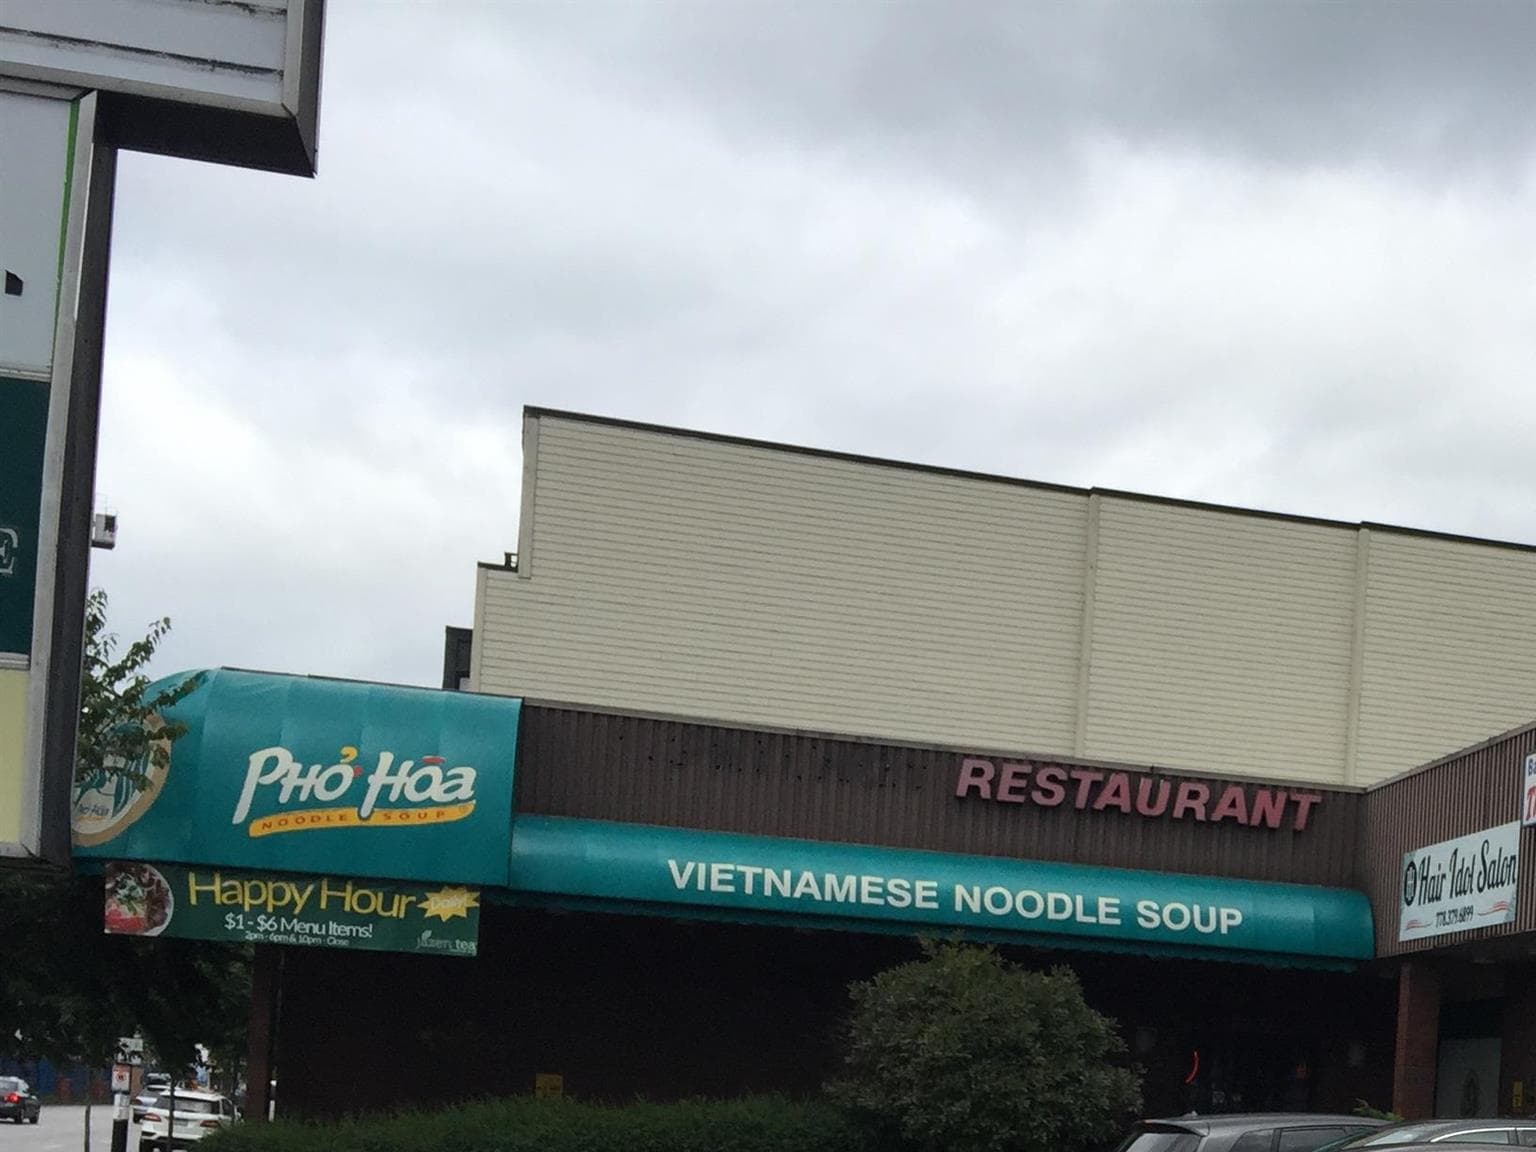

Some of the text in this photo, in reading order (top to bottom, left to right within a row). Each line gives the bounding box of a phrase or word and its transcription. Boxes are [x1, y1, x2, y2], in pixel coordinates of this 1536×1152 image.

[261, 810, 446, 830] NOODLE SOUP
[955, 758, 1322, 832] RESTAURANT
[188, 871, 417, 919] Happy Hour
[668, 859, 1244, 935] VIETNAMESE NOODLE SOUP
[1418, 839, 1516, 906] Hair Idol Salon
[224, 912, 244, 930] $1
[257, 914, 278, 932] $6
[280, 917, 327, 934] Menu
[329, 922, 373, 938] Items!
